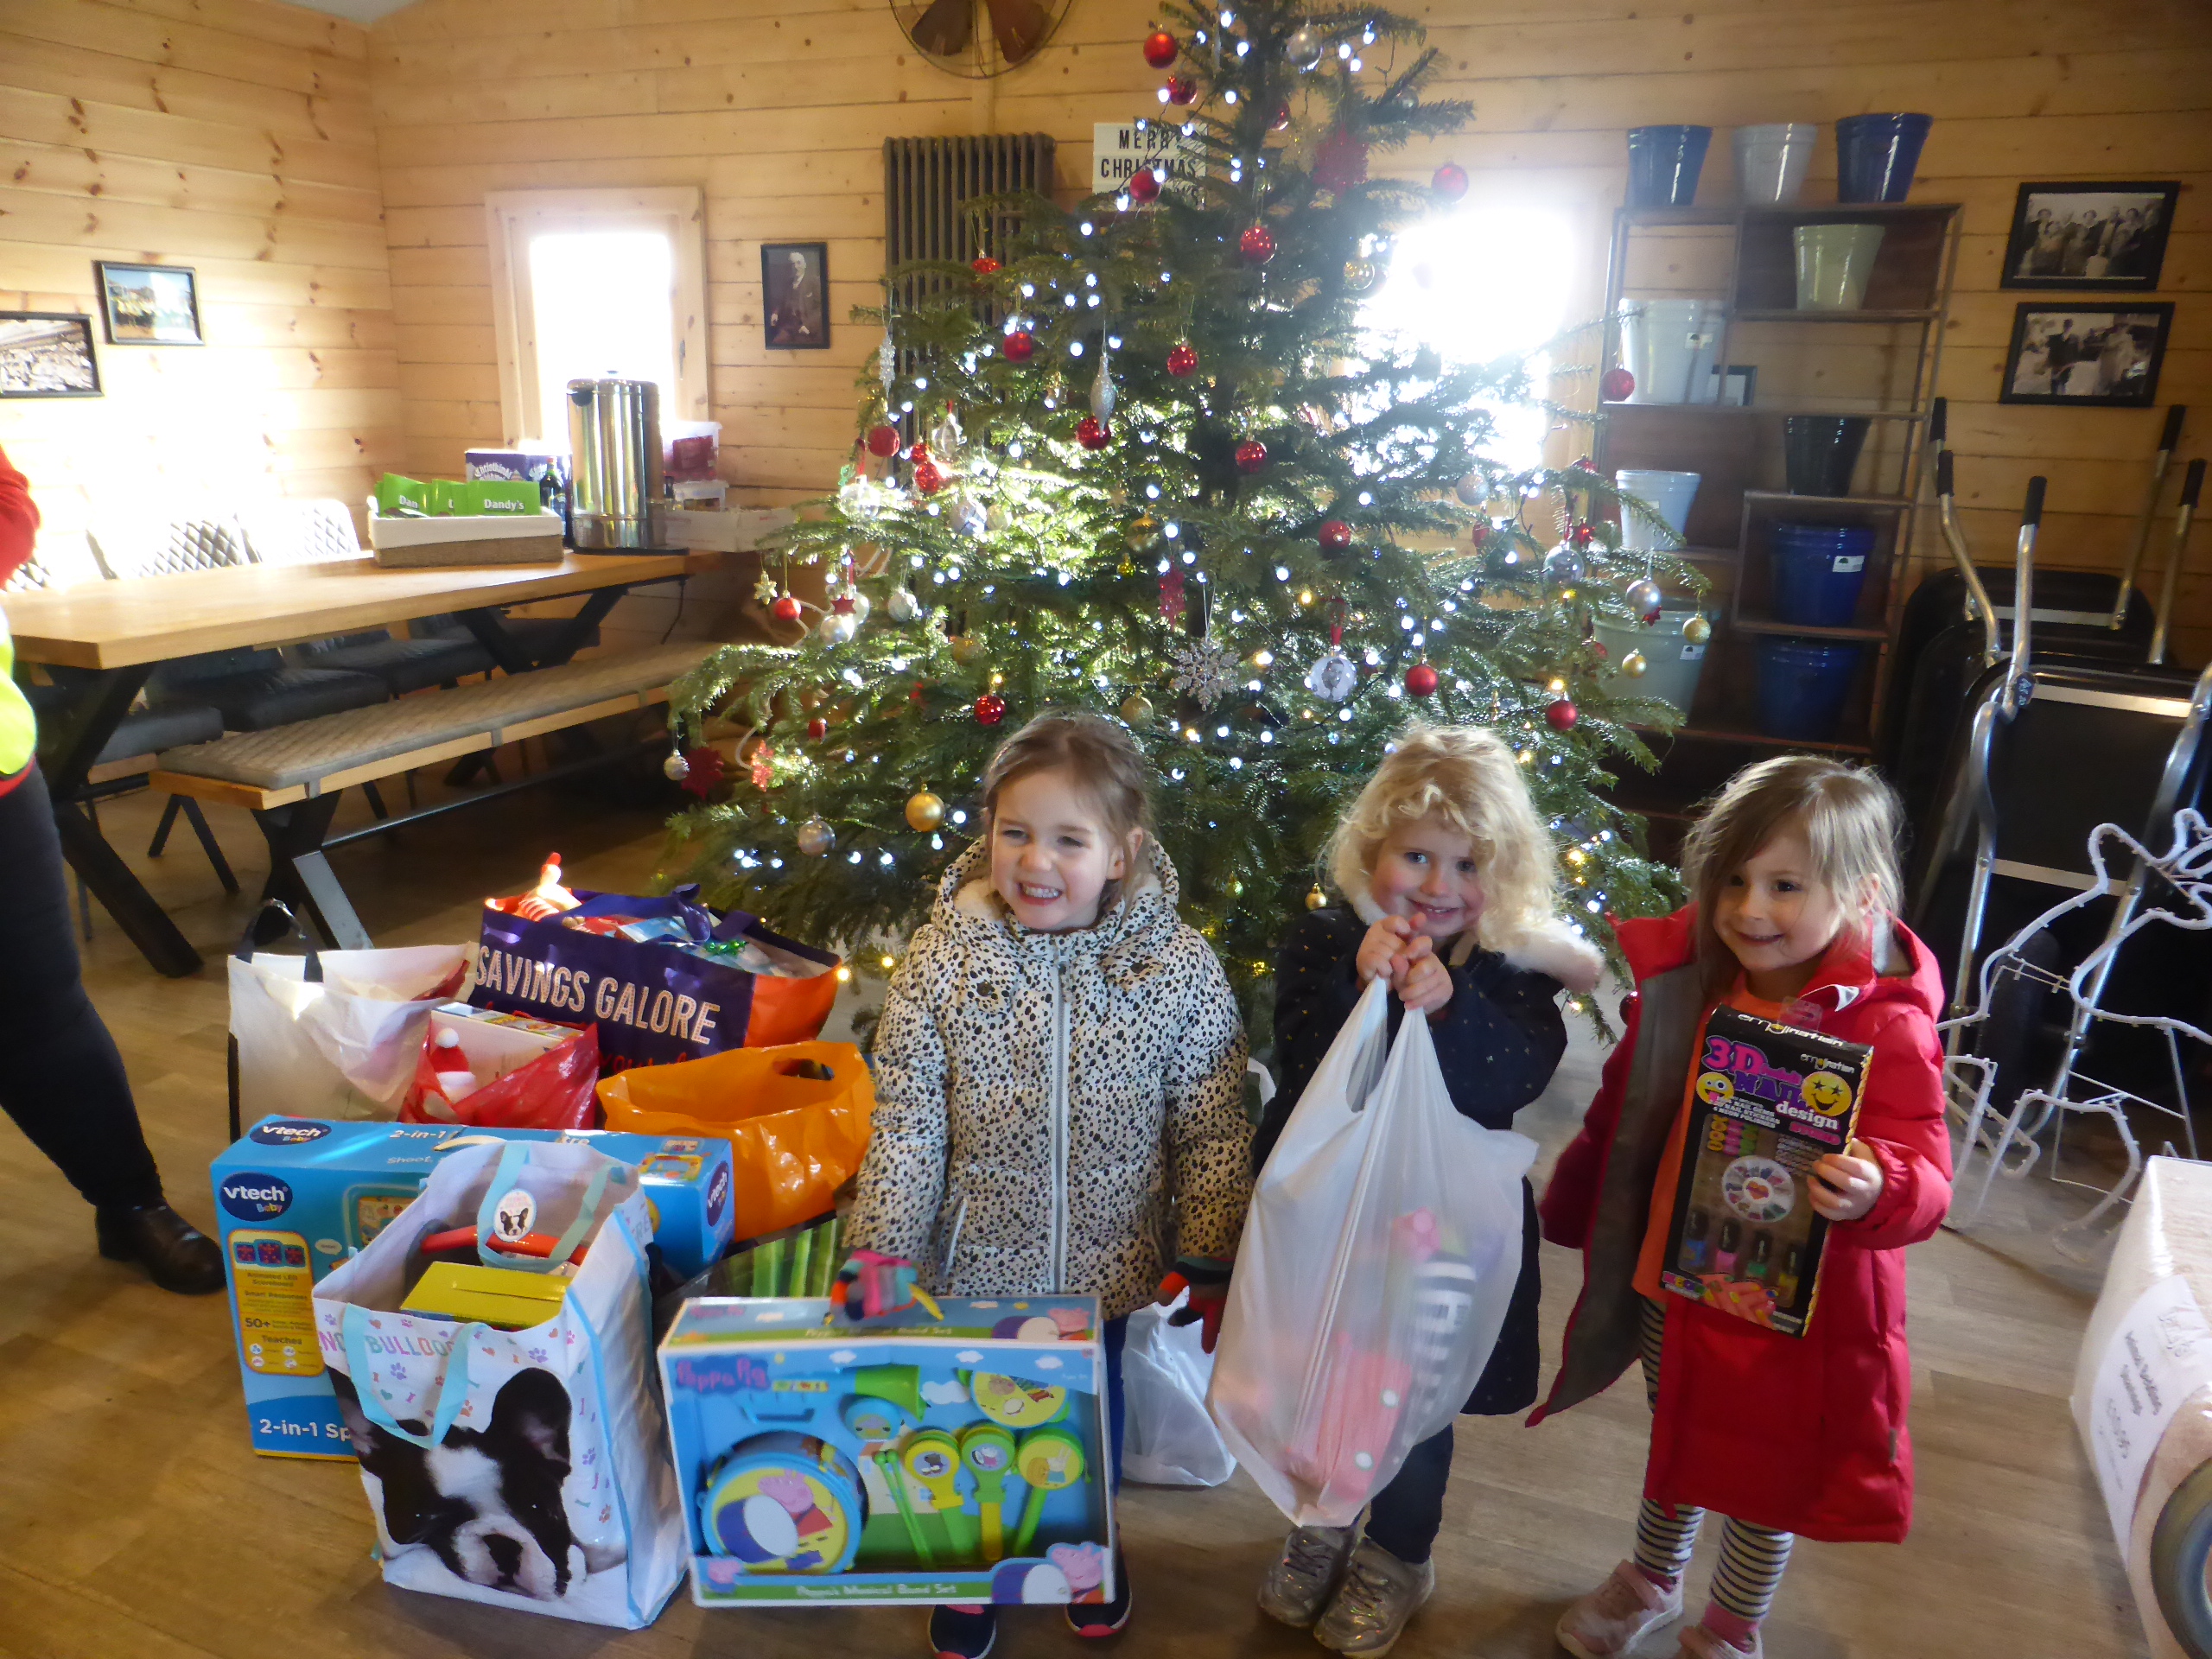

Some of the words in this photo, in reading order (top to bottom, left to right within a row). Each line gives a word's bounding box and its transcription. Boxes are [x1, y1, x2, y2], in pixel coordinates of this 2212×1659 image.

[1119, 130, 1177, 149] MERR
[1101, 158, 1196, 178] CHRITMAS
[484, 499, 524, 510] Dandy's
[475, 945, 589, 1012] SAVINGS
[595, 977, 720, 1045] GALORE
[1701, 1035, 1767, 1077] 3D
[1776, 1100, 1839, 1130] design
[263, 1125, 322, 1137] vtech
[390, 1130, 447, 1139] 2-in-1
[224, 1185, 285, 1202] vtech
[259, 1418, 318, 1437] 2-in-1
